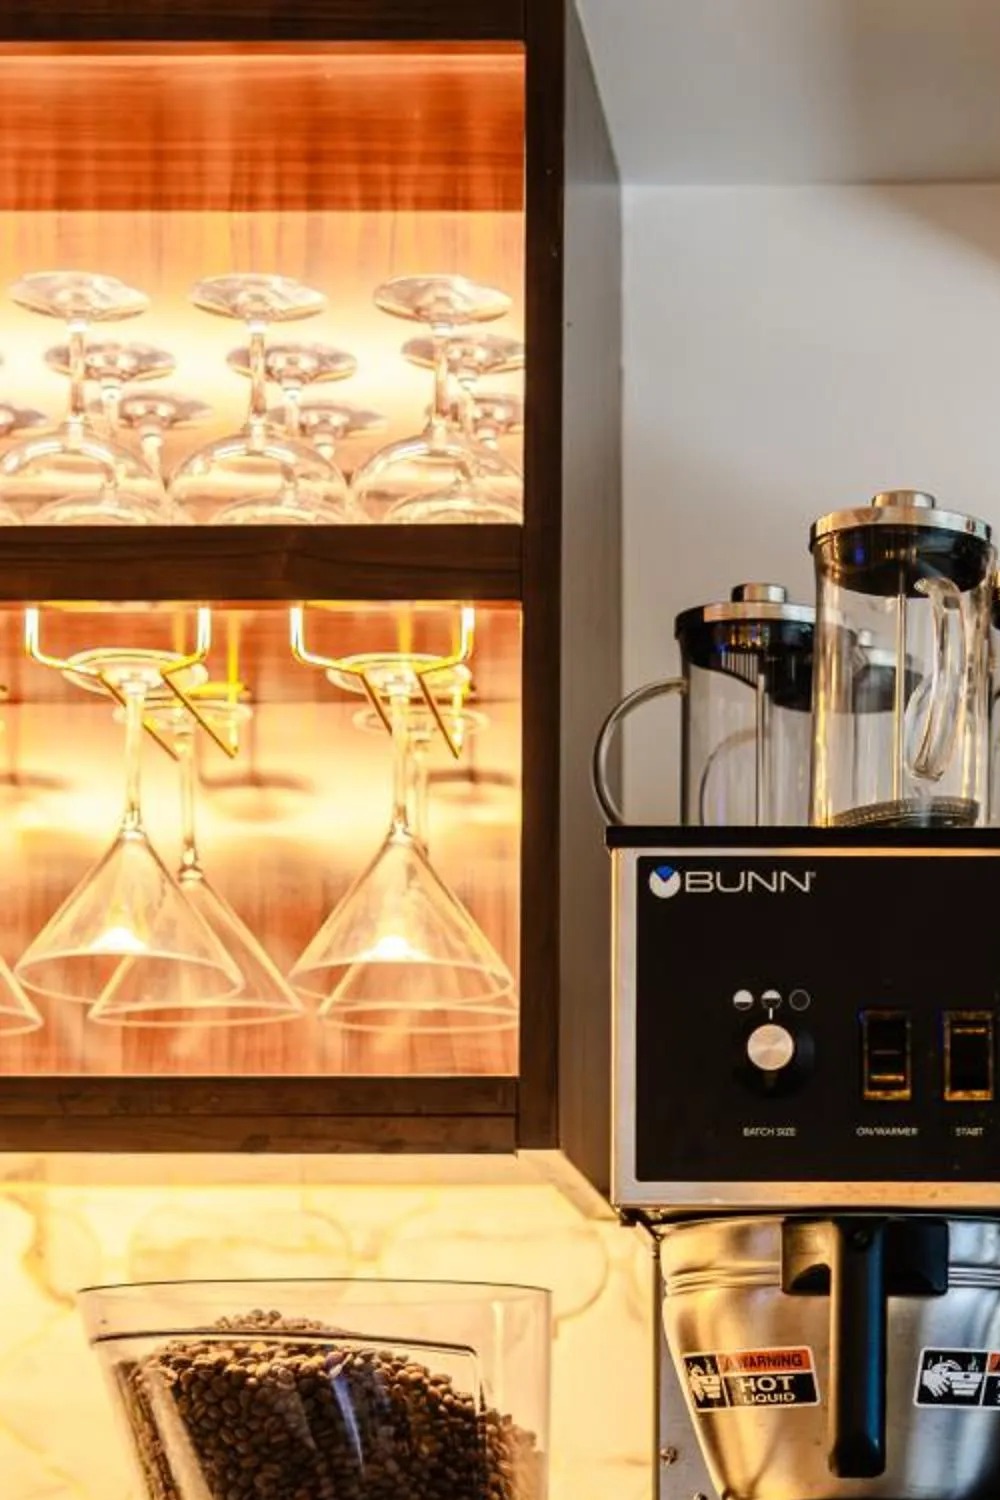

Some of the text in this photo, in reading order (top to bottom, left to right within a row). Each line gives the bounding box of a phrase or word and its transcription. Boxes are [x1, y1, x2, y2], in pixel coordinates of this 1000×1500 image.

[685, 871, 810, 893] BUNN
[742, 1127, 797, 1137] BATCH SIZE
[955, 1127, 984, 1137] START
[737, 1375, 794, 1392] HOT
[742, 1391, 796, 1404] LIQUID
